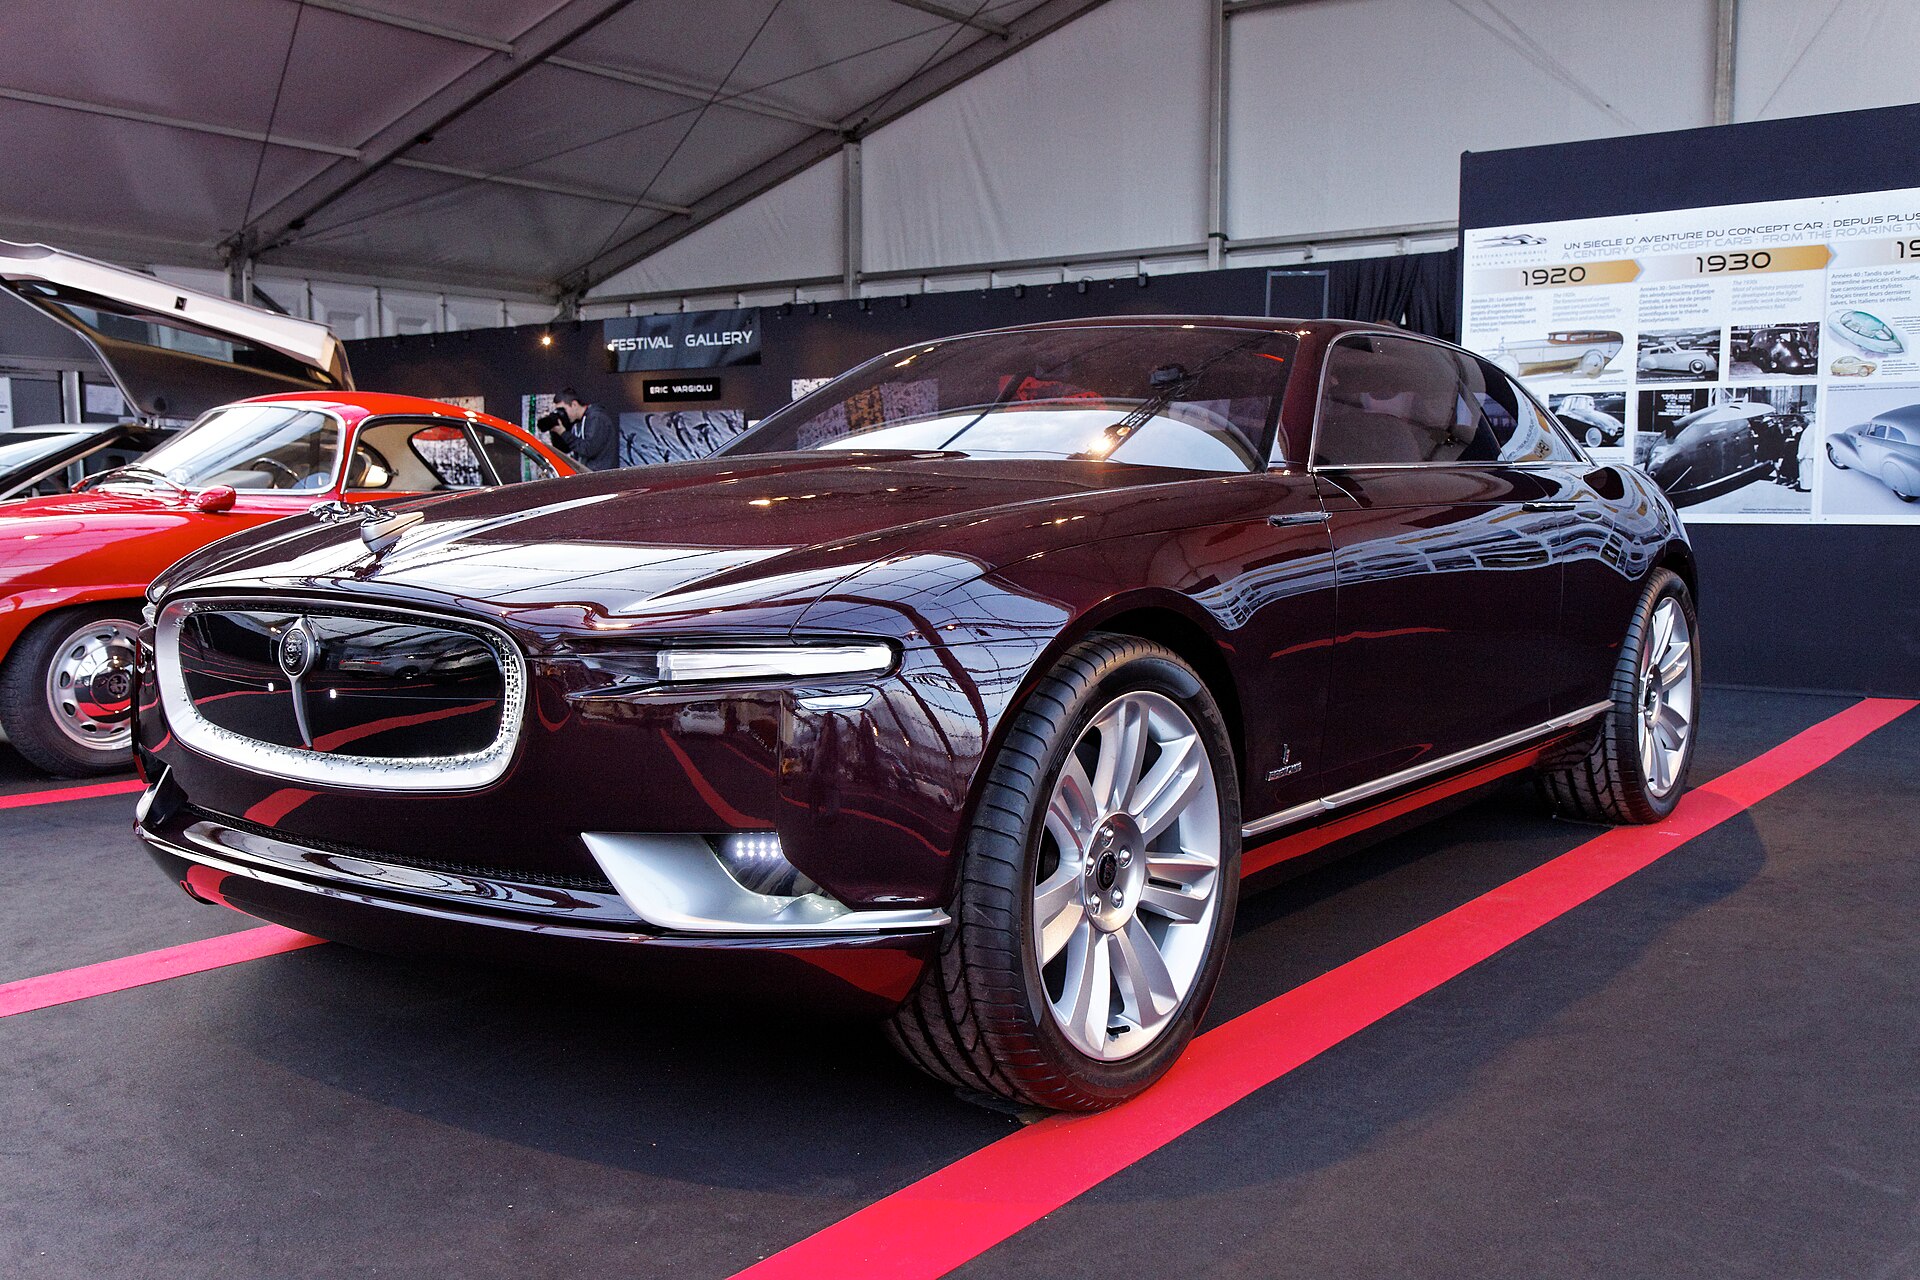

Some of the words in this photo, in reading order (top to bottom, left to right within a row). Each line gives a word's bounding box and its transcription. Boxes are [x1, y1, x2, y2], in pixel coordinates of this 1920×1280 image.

[1564, 242, 1580, 250] UN
[1638, 231, 1703, 244] AVENTURE
[1707, 229, 1725, 238] DU
[1728, 224, 1790, 236] CONCEPT
[1794, 221, 1823, 231] CAR
[1833, 216, 1883, 228] DEPUIS
[1573, 246, 1630, 258] CENTURY
[1632, 244, 1649, 253] OF
[1652, 239, 1713, 252] CONCEPT
[1714, 236, 1752, 246] CARS
[1762, 232, 1803, 243] FROM
[1808, 230, 1832, 240] THE
[1836, 224, 1902, 237] ROARING
[1696, 252, 1771, 273] 1930
[1522, 266, 1586, 286] 1920
[611, 336, 673, 351] FESTIVAL
[685, 331, 752, 347] GALLERY
[649, 386, 669, 394] ERIC
[672, 384, 713, 393] VARGIOLU
